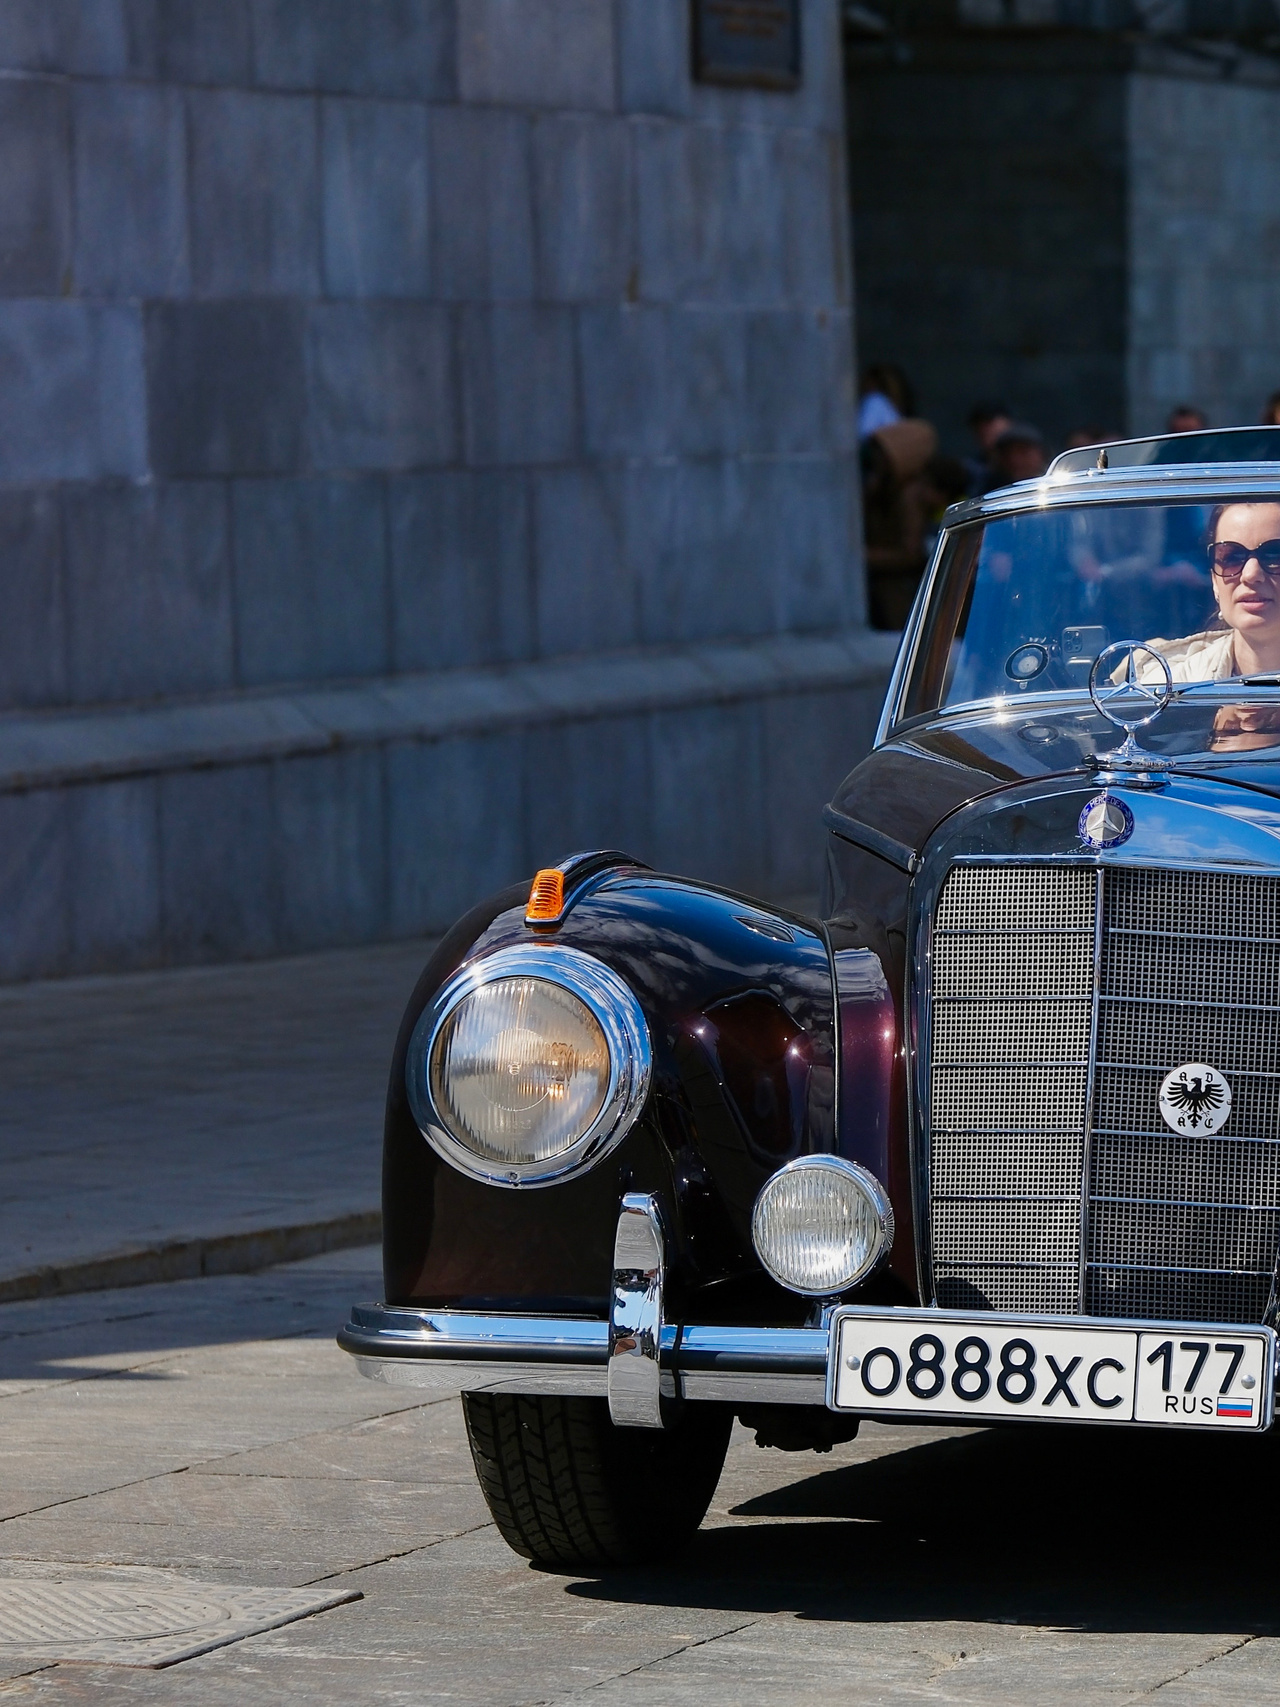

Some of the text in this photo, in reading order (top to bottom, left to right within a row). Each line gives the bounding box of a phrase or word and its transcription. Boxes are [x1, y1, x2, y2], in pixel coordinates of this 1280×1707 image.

[1090, 796, 1125, 808] MERCEDES
[1090, 839, 1114, 848] BENZ
[1146, 1340, 1246, 1394] 177
[1165, 1395, 1214, 1415] RUS
